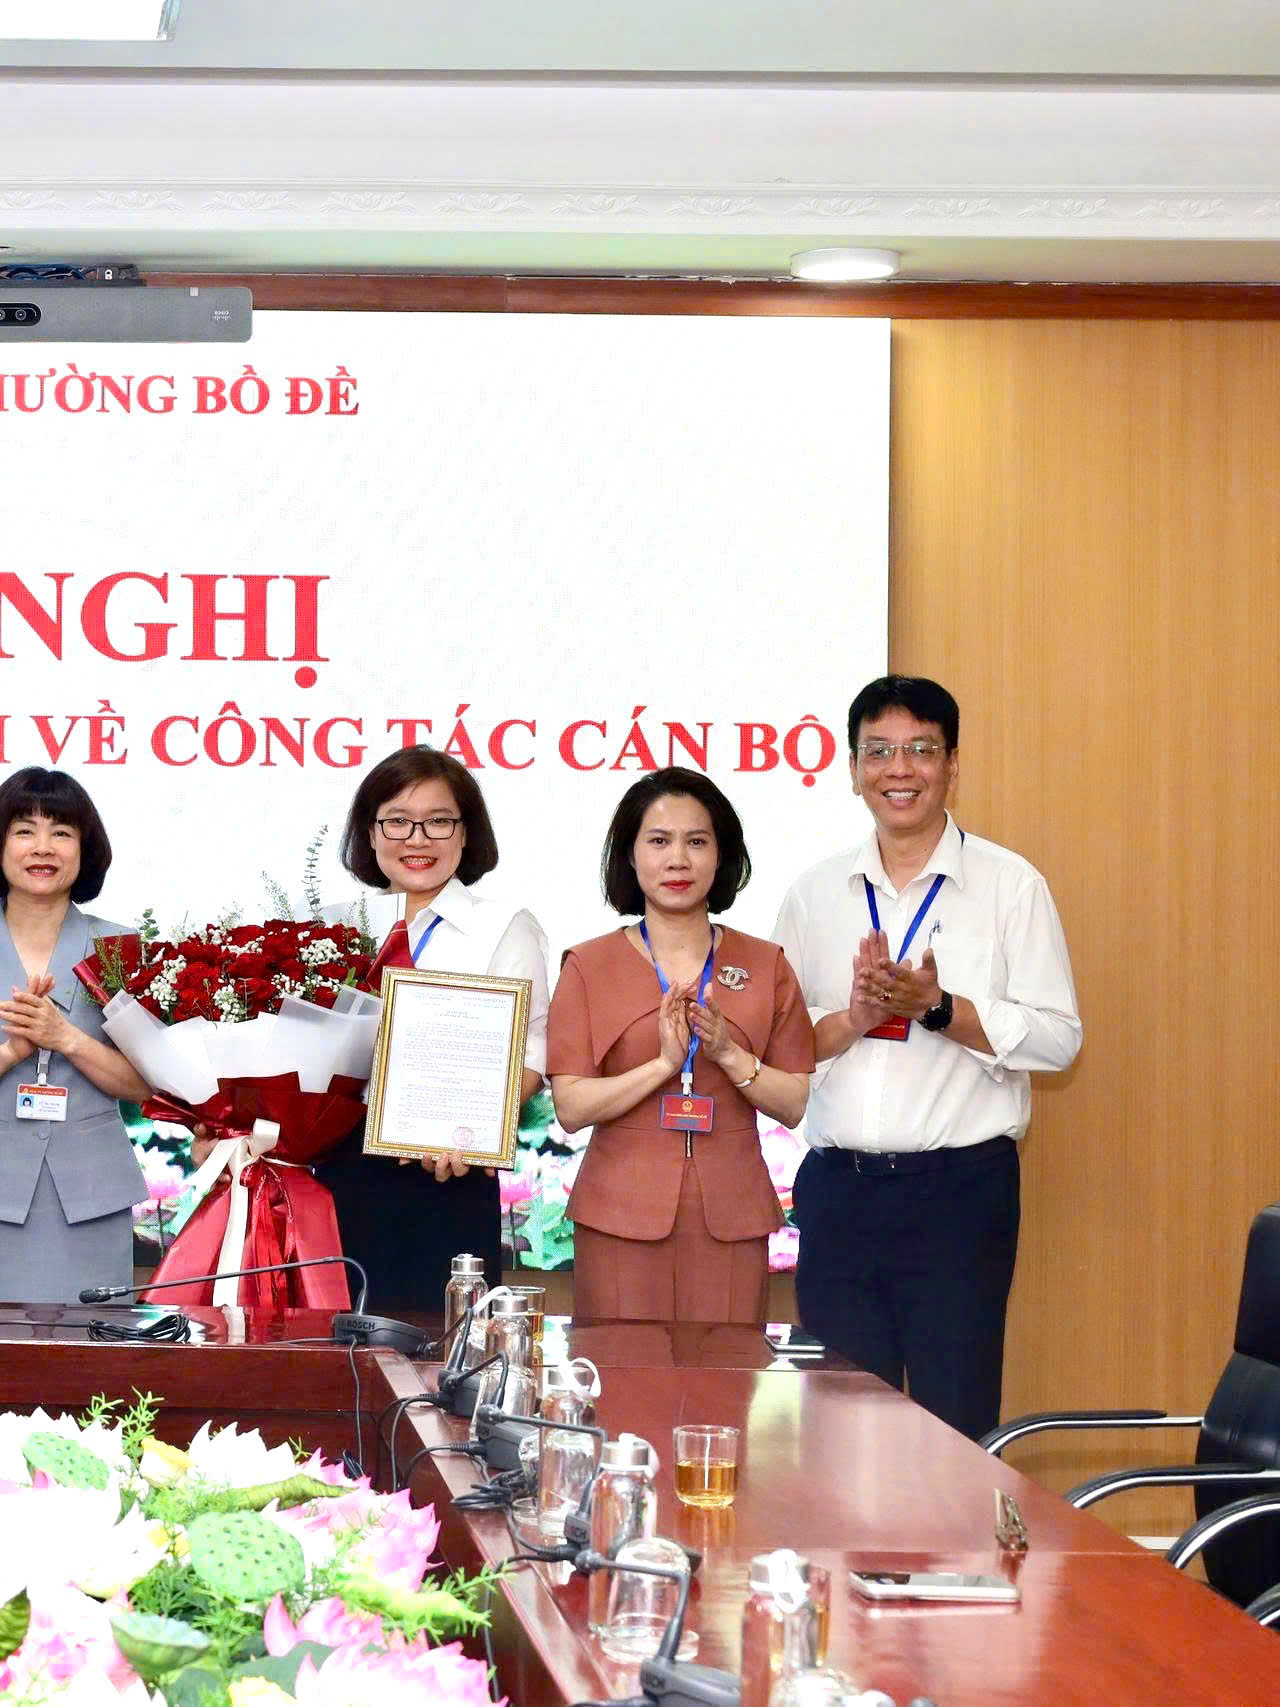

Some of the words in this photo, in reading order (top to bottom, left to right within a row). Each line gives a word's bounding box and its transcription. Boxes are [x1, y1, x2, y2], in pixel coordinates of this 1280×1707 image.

[194, 364, 271, 415] BỒ
[286, 366, 360, 416] ĐỀ
[30, 699, 128, 765] VỀ
[150, 700, 370, 769] CÔNG
[385, 703, 537, 771] TÁC
[558, 705, 713, 773] CÁN
[732, 713, 838, 788] BỘ
[347, 1320, 376, 1330] BOSCH
